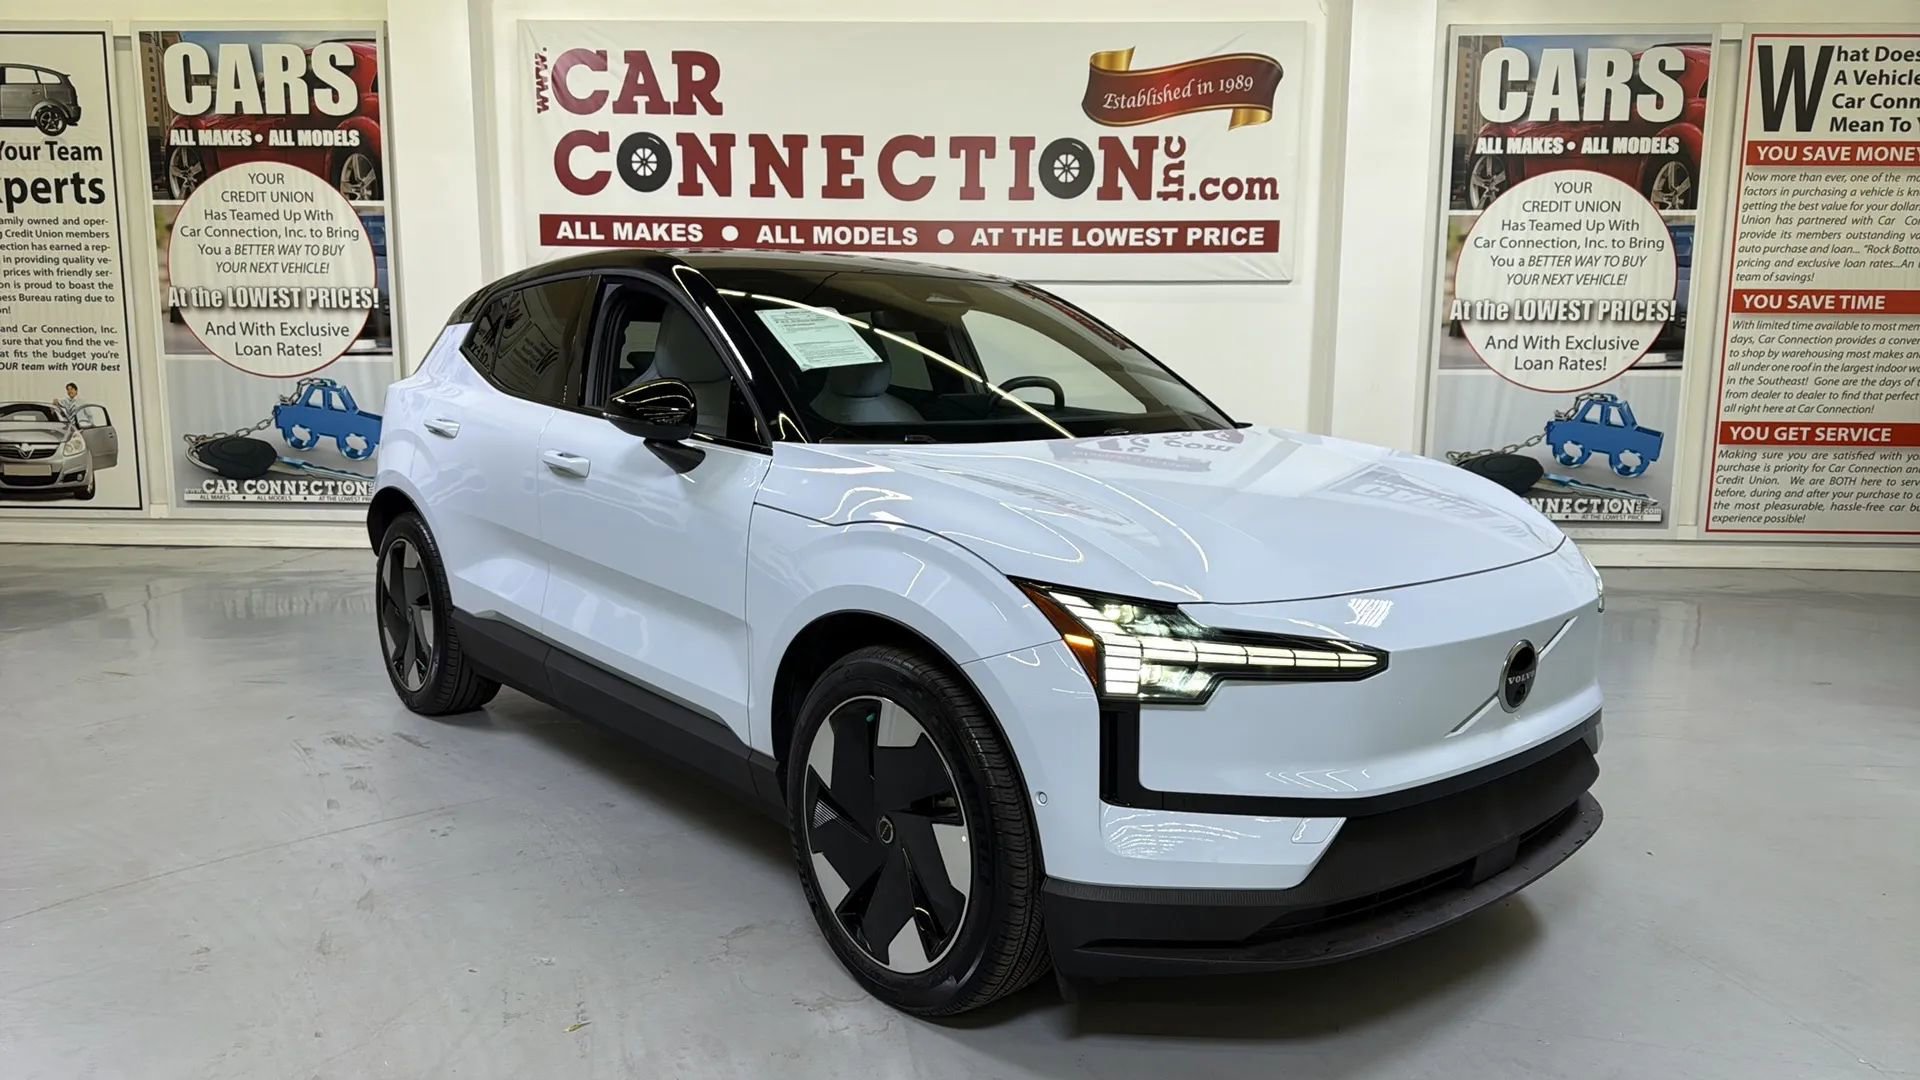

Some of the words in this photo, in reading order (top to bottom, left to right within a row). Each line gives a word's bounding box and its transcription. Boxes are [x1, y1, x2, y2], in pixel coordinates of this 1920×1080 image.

[163, 42, 358, 116] CARS
[551, 48, 723, 115] CAR
[1478, 46, 1686, 123] CARS
[1834, 70, 1848, 85] A
[1102, 87, 1192, 109] Established
[1197, 80, 1214, 94] in
[1219, 76, 1254, 92] 1989
[1832, 93, 1865, 108] Car
[1830, 117, 1884, 132] Mean
[1890, 117, 1912, 132] To
[170, 130, 197, 146] ALL
[198, 130, 252, 146] MAKES
[268, 130, 294, 146] ALL
[297, 130, 360, 147] MODELS
[1476, 137, 1503, 154] ALL
[1507, 137, 1564, 154] MAKES
[1581, 137, 1610, 154] ALL
[1612, 137, 1680, 154] MODELS
[45, 141, 102, 160] Team
[1757, 146, 1798, 160] YOU
[1803, 146, 1851, 160] SAVE
[554, 129, 1159, 201] CONNECTION
[248, 173, 284, 184] YOUR
[0, 172, 105, 213] perts
[1188, 176, 1280, 201] .com
[1554, 182, 1592, 193] YOUR
[221, 191, 266, 202] CREDIT
[271, 191, 314, 203] UNION
[1522, 201, 1572, 212] CREDIT
[1575, 200, 1621, 212] UNION
[27, 217, 59, 225] owned
[63, 217, 80, 225] and
[83, 219, 108, 227] oper-
[204, 209, 227, 220] Has
[229, 209, 279, 221] Teamed
[284, 209, 301, 223] Up
[304, 209, 333, 221] With
[5, 229, 33, 238] Credit
[35, 229, 63, 238] Union
[66, 230, 110, 238] members
[180, 226, 201, 237] Car
[205, 226, 281, 239] Connection,
[285, 227, 306, 238] Inc.
[310, 228, 322, 238] to
[327, 227, 359, 241] Bring
[557, 222, 604, 240] ALL
[612, 222, 703, 242] MAKES
[757, 226, 804, 244] ALL
[813, 226, 917, 246] MODELS
[971, 228, 1003, 246] AT
[1012, 228, 1062, 246] THE
[1072, 227, 1178, 246] LOWEST
[1187, 227, 1264, 246] PRICE
[1502, 220, 1525, 231] Has
[1529, 219, 1582, 231] Teamed
[1586, 220, 1605, 234] Up
[1609, 219, 1639, 231] With
[31, 242, 47, 250] has
[49, 243, 82, 251] earned
[92, 245, 110, 253] rep-
[198, 244, 221, 255] You
[225, 247, 231, 255] a
[234, 244, 275, 255] BETTER
[278, 244, 302, 256] WAY
[304, 244, 320, 256] TO
[322, 245, 345, 256] BUY
[1474, 237, 1496, 248] Car
[1500, 237, 1580, 250] Connection,
[1585, 237, 1607, 248] Inc.
[1612, 239, 1625, 248] to
[1630, 237, 1664, 252] Bring
[3, 255, 12, 263] in
[14, 255, 59, 265] providing
[62, 255, 94, 265] quality
[1490, 256, 1514, 267] You
[1519, 258, 1525, 267] a
[1528, 255, 1572, 267] BETTER
[1575, 256, 1602, 267] WAY
[1604, 255, 1620, 267] TO
[1622, 256, 1647, 267] BUY
[3, 268, 30, 278] prices
[33, 268, 54, 276] with
[56, 268, 92, 279] friendly
[216, 262, 247, 273] YOUR
[249, 262, 279, 273] NEXT
[281, 262, 329, 274] VEHICLE!
[1507, 273, 1542, 285] YOUR
[1541, 274, 1574, 285] NEXT
[1576, 274, 1628, 285] VEHICLE!
[1736, 273, 1761, 281] team
[1763, 272, 1776, 281] of
[1774, 272, 1815, 284] savings!
[168, 286, 187, 306] At
[192, 286, 223, 307] the
[226, 287, 301, 308] LOWEST
[306, 287, 379, 308] PRICES!
[1743, 294, 1782, 309] YOU
[1788, 294, 1836, 310] SAVE
[1840, 295, 1886, 310] TIME
[1450, 299, 1470, 320] At
[1476, 299, 1509, 321] the
[1514, 300, 1593, 321] LOWEST
[1598, 300, 1676, 322] PRICES!
[205, 321, 236, 336] And
[239, 322, 275, 336] With
[280, 322, 349, 337] Exclusive
[235, 342, 272, 356] Loan
[277, 342, 321, 356] Rates!
[1485, 335, 1518, 349] And
[1523, 335, 1560, 350] With
[1566, 335, 1639, 350] Exclusive
[1515, 356, 1553, 370] Loan
[1559, 356, 1607, 371] Rates!
[1725, 389, 1748, 399] from
[1751, 390, 1781, 399] dealer
[1796, 390, 1827, 400] dealer
[1829, 392, 1839, 400] to
[1841, 390, 1861, 400] find
[1863, 391, 1883, 400] that
[1724, 403, 1737, 412] all
[1736, 404, 1761, 415] right
[1763, 404, 1786, 413] here
[1785, 405, 1796, 413] at
[1798, 404, 1815, 413] Car
[1816, 404, 1875, 414] Connection!
[1730, 426, 1770, 440] YOU
[1774, 427, 1811, 442] GET
[1815, 427, 1892, 442] SERVICE
[1718, 449, 1757, 461] Making
[1787, 451, 1807, 461] you
[1811, 452, 1828, 460] are
[1833, 450, 1876, 460] satisfied
[1878, 450, 1903, 460] with
[202, 480, 238, 494] CAR
[244, 480, 368, 496] CONNECTION
[1712, 514, 1764, 524] experience
[1763, 514, 1806, 524] possible!
